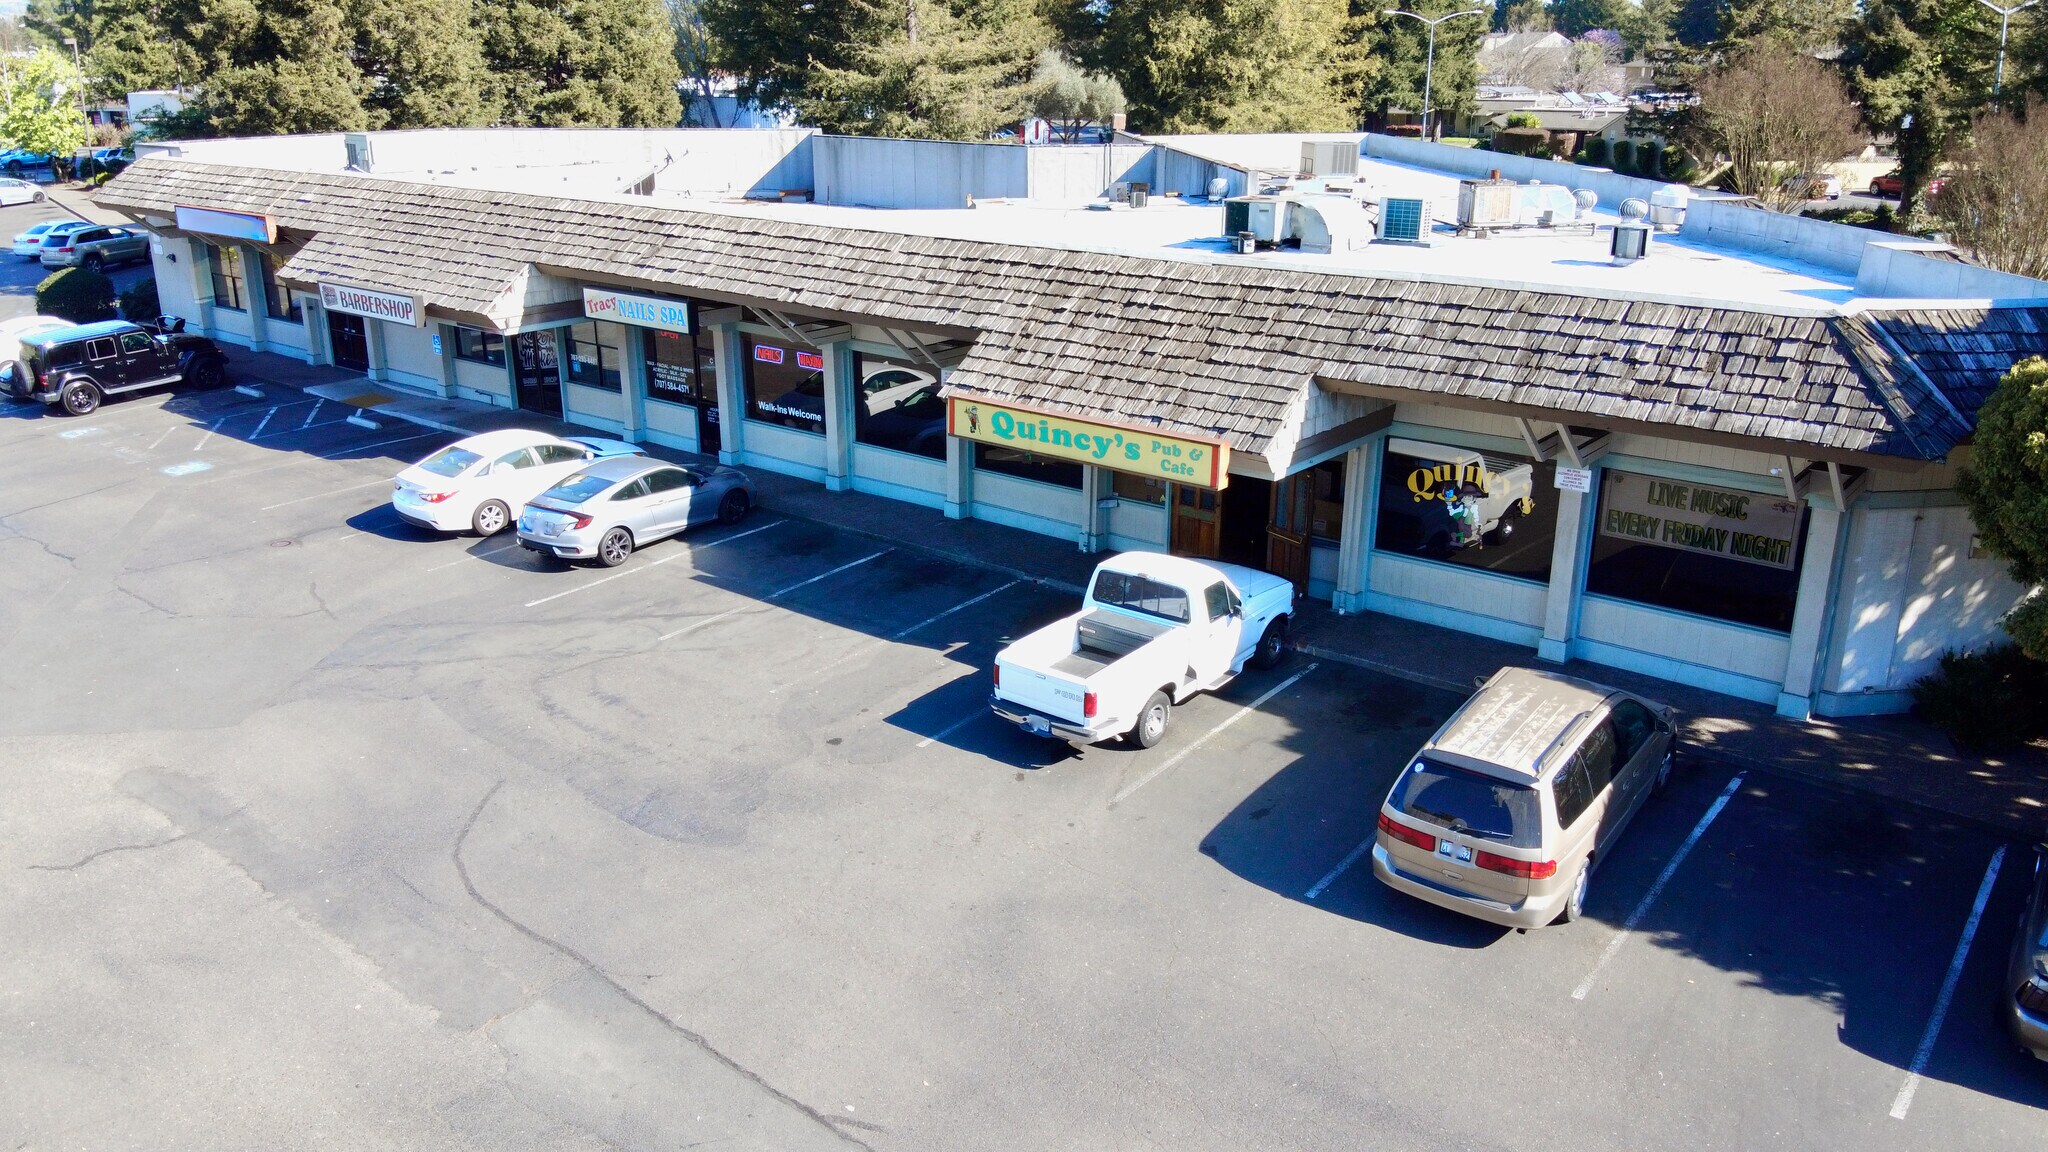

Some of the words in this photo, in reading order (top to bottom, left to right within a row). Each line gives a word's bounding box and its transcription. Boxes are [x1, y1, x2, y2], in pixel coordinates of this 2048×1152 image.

[340, 290, 412, 320] BARBERSHOP
[587, 297, 616, 313] Tracy
[617, 299, 655, 321] NAILS
[660, 306, 686, 327] SPA
[757, 347, 780, 362] NAILS
[799, 355, 823, 369] WAXIN
[654, 378, 667, 390] (707)
[758, 401, 788, 415] Walk-Ins
[788, 407, 822, 422] Welcome
[991, 411, 1141, 460] Quincy's
[1152, 440, 1182, 458] Pub
[1189, 448, 1203, 461] &
[1161, 458, 1195, 476] Cafe
[1647, 480, 1690, 510] LIVE
[1690, 487, 1750, 520] MUSIC
[1606, 509, 1661, 540] EVERY
[1662, 519, 1730, 553] FRIDAY
[1730, 531, 1791, 564] NIGHT
